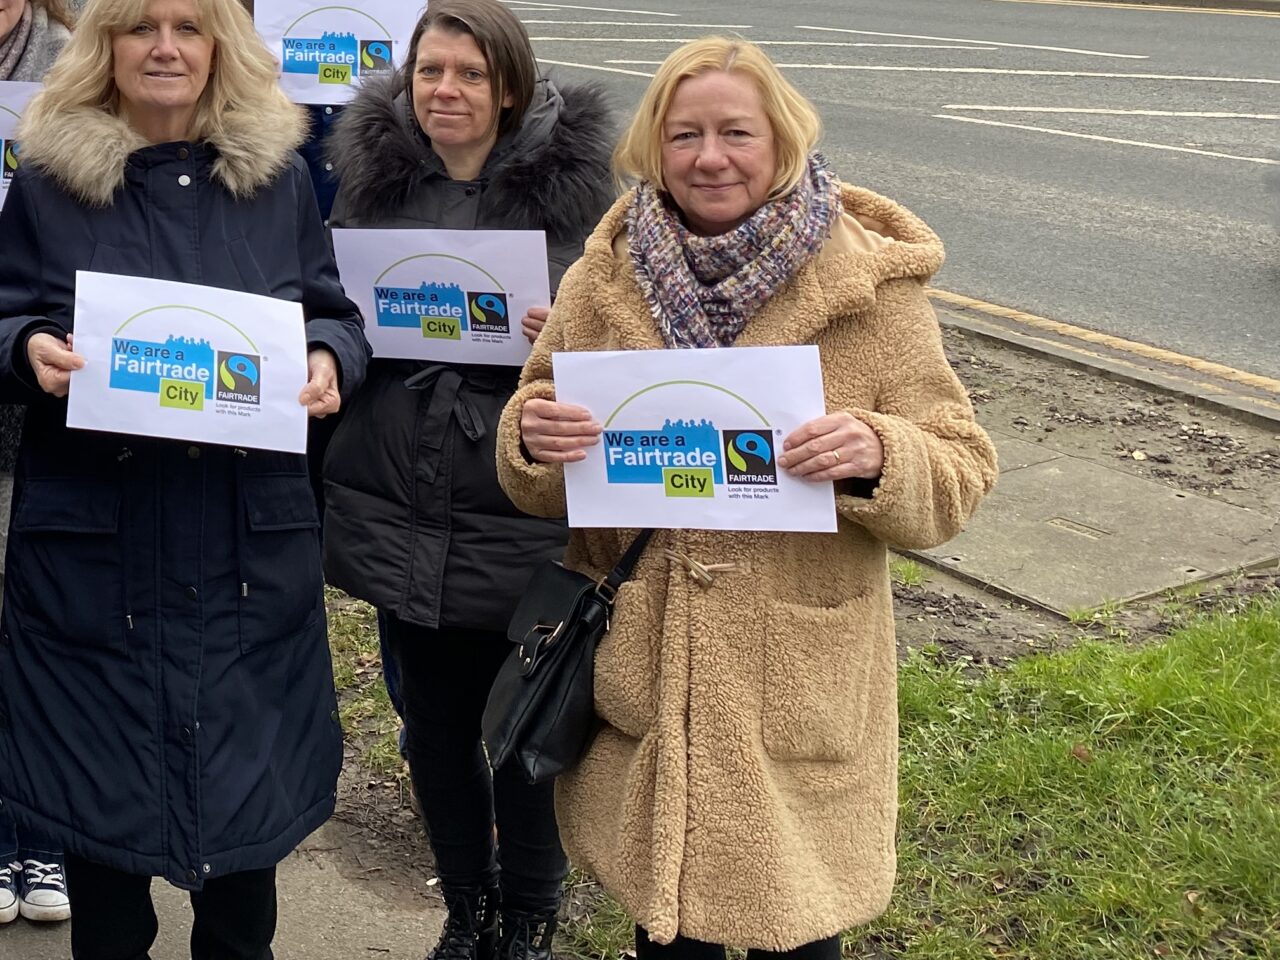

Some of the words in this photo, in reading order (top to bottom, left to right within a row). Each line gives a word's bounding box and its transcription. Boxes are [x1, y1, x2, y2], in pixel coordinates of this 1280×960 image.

[284, 39, 302, 49] We
[306, 42, 325, 50] are
[329, 42, 335, 50] a
[285, 49, 355, 63] Fairtrade
[323, 68, 347, 80] City
[376, 288, 398, 300] We
[402, 291, 425, 301] are
[430, 292, 438, 301] a
[378, 299, 463, 317] Fairtrade
[427, 321, 455, 336] City
[472, 324, 508, 332] FAIRTRADE
[114, 339, 139, 355] We
[144, 346, 170, 359] are
[175, 350, 184, 361] a
[114, 354, 209, 381] Fairtrade
[166, 385, 199, 405] City
[218, 392, 258, 402] FAIRTRADE
[604, 432, 634, 446] We
[640, 434, 669, 446] are
[674, 434, 685, 446] a
[609, 447, 717, 467] Fairtrade
[671, 473, 707, 493] City
